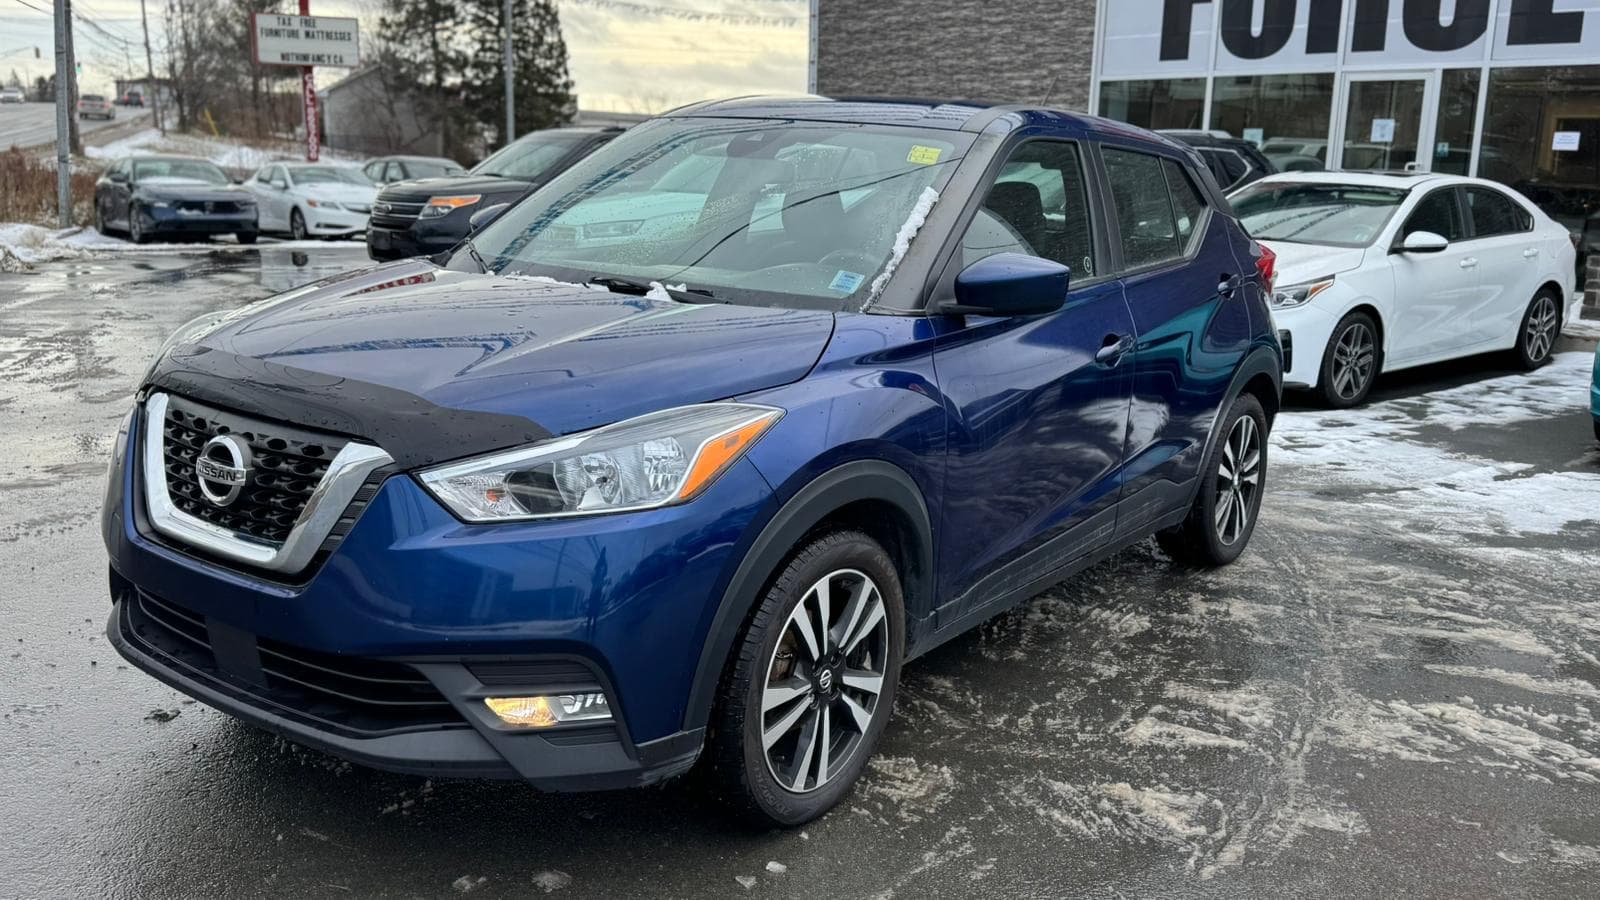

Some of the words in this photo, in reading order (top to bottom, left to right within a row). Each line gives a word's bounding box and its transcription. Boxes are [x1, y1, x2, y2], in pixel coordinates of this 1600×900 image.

[277, 17, 292, 27] TAX
[300, 18, 316, 28] FREE
[260, 28, 299, 39] FURNITURE
[305, 30, 352, 41] MATTRESSES
[198, 462, 236, 481] NISSAN
